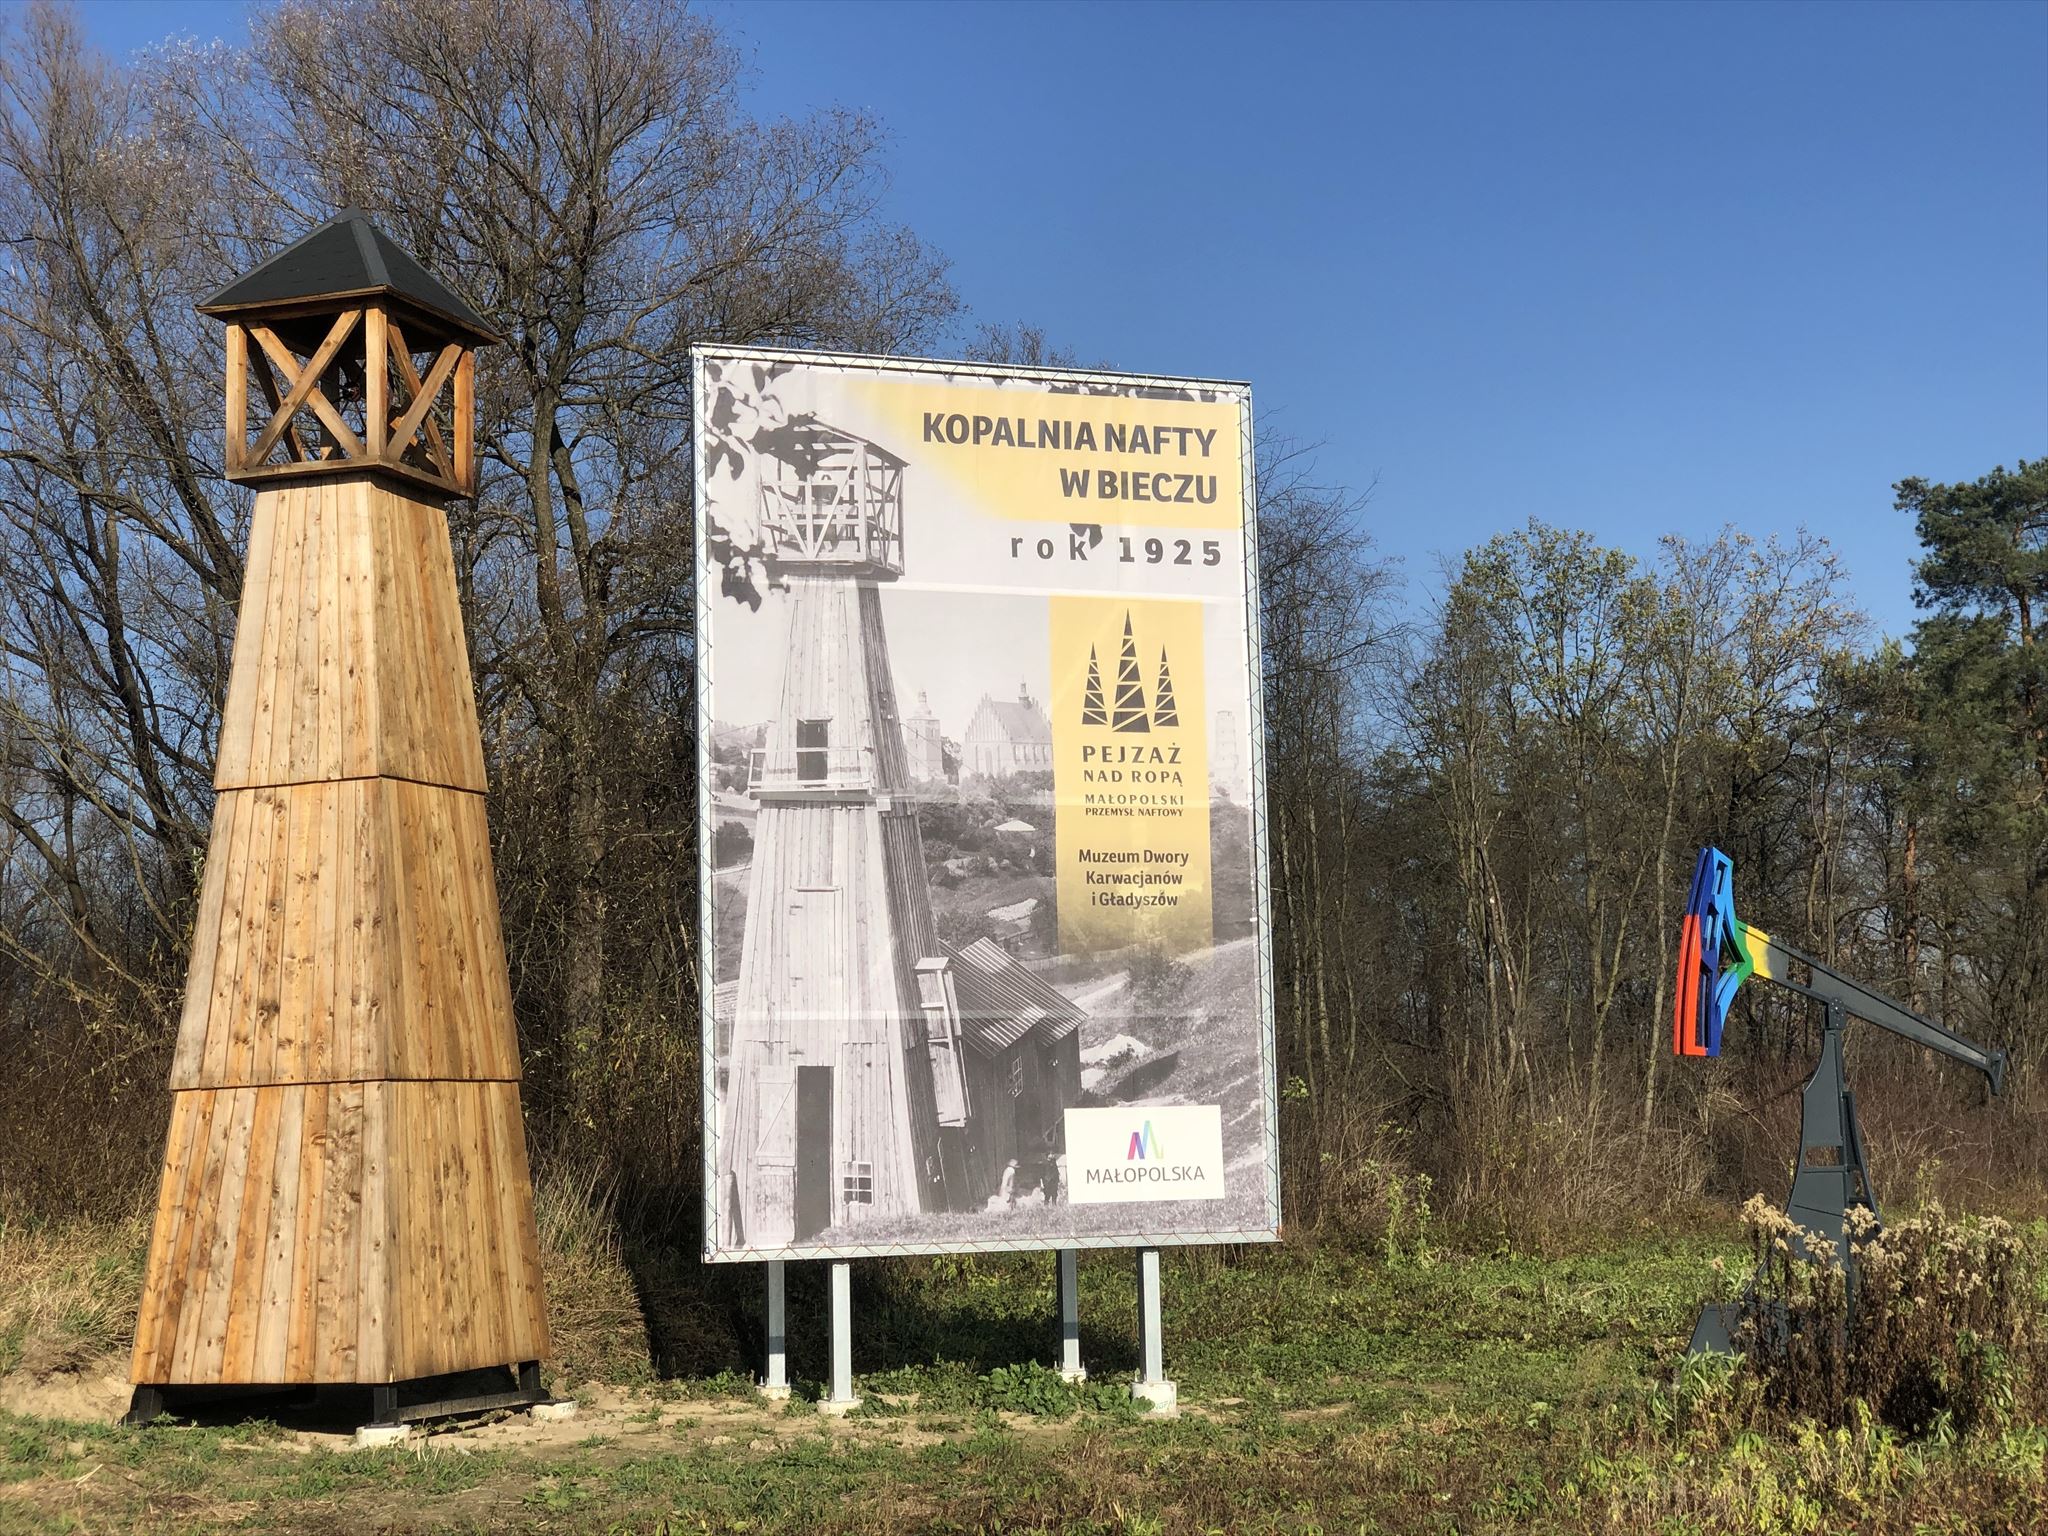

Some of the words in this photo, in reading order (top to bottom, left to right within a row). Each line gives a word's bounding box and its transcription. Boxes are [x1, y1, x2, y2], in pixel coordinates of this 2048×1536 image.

[923, 412, 1097, 451] KOPALNIA
[1104, 423, 1217, 457] NAFTY
[1060, 468, 1090, 498] W
[1098, 470, 1217, 504] BIECZU
[1011, 534, 1087, 561] rok
[1119, 537, 1221, 567] 1925
[1082, 742, 1182, 764] PEJZAŻ
[1083, 770, 1123, 782] NAD
[1131, 771, 1183, 787] ROPĄ
[1085, 794, 1184, 806] MAŁOPOLSKI
[1085, 807, 1135, 816] PRZEMYSŁ
[1137, 808, 1184, 817] NAFTOWY
[1078, 849, 1140, 863] Muzeum
[1143, 850, 1189, 867] Dwory
[1086, 871, 1183, 888] Karwacjanów
[1091, 892, 1096, 906] i
[1099, 892, 1178, 909] Gładyszów
[1086, 1165, 1205, 1184] MAŁOPOLSKA
